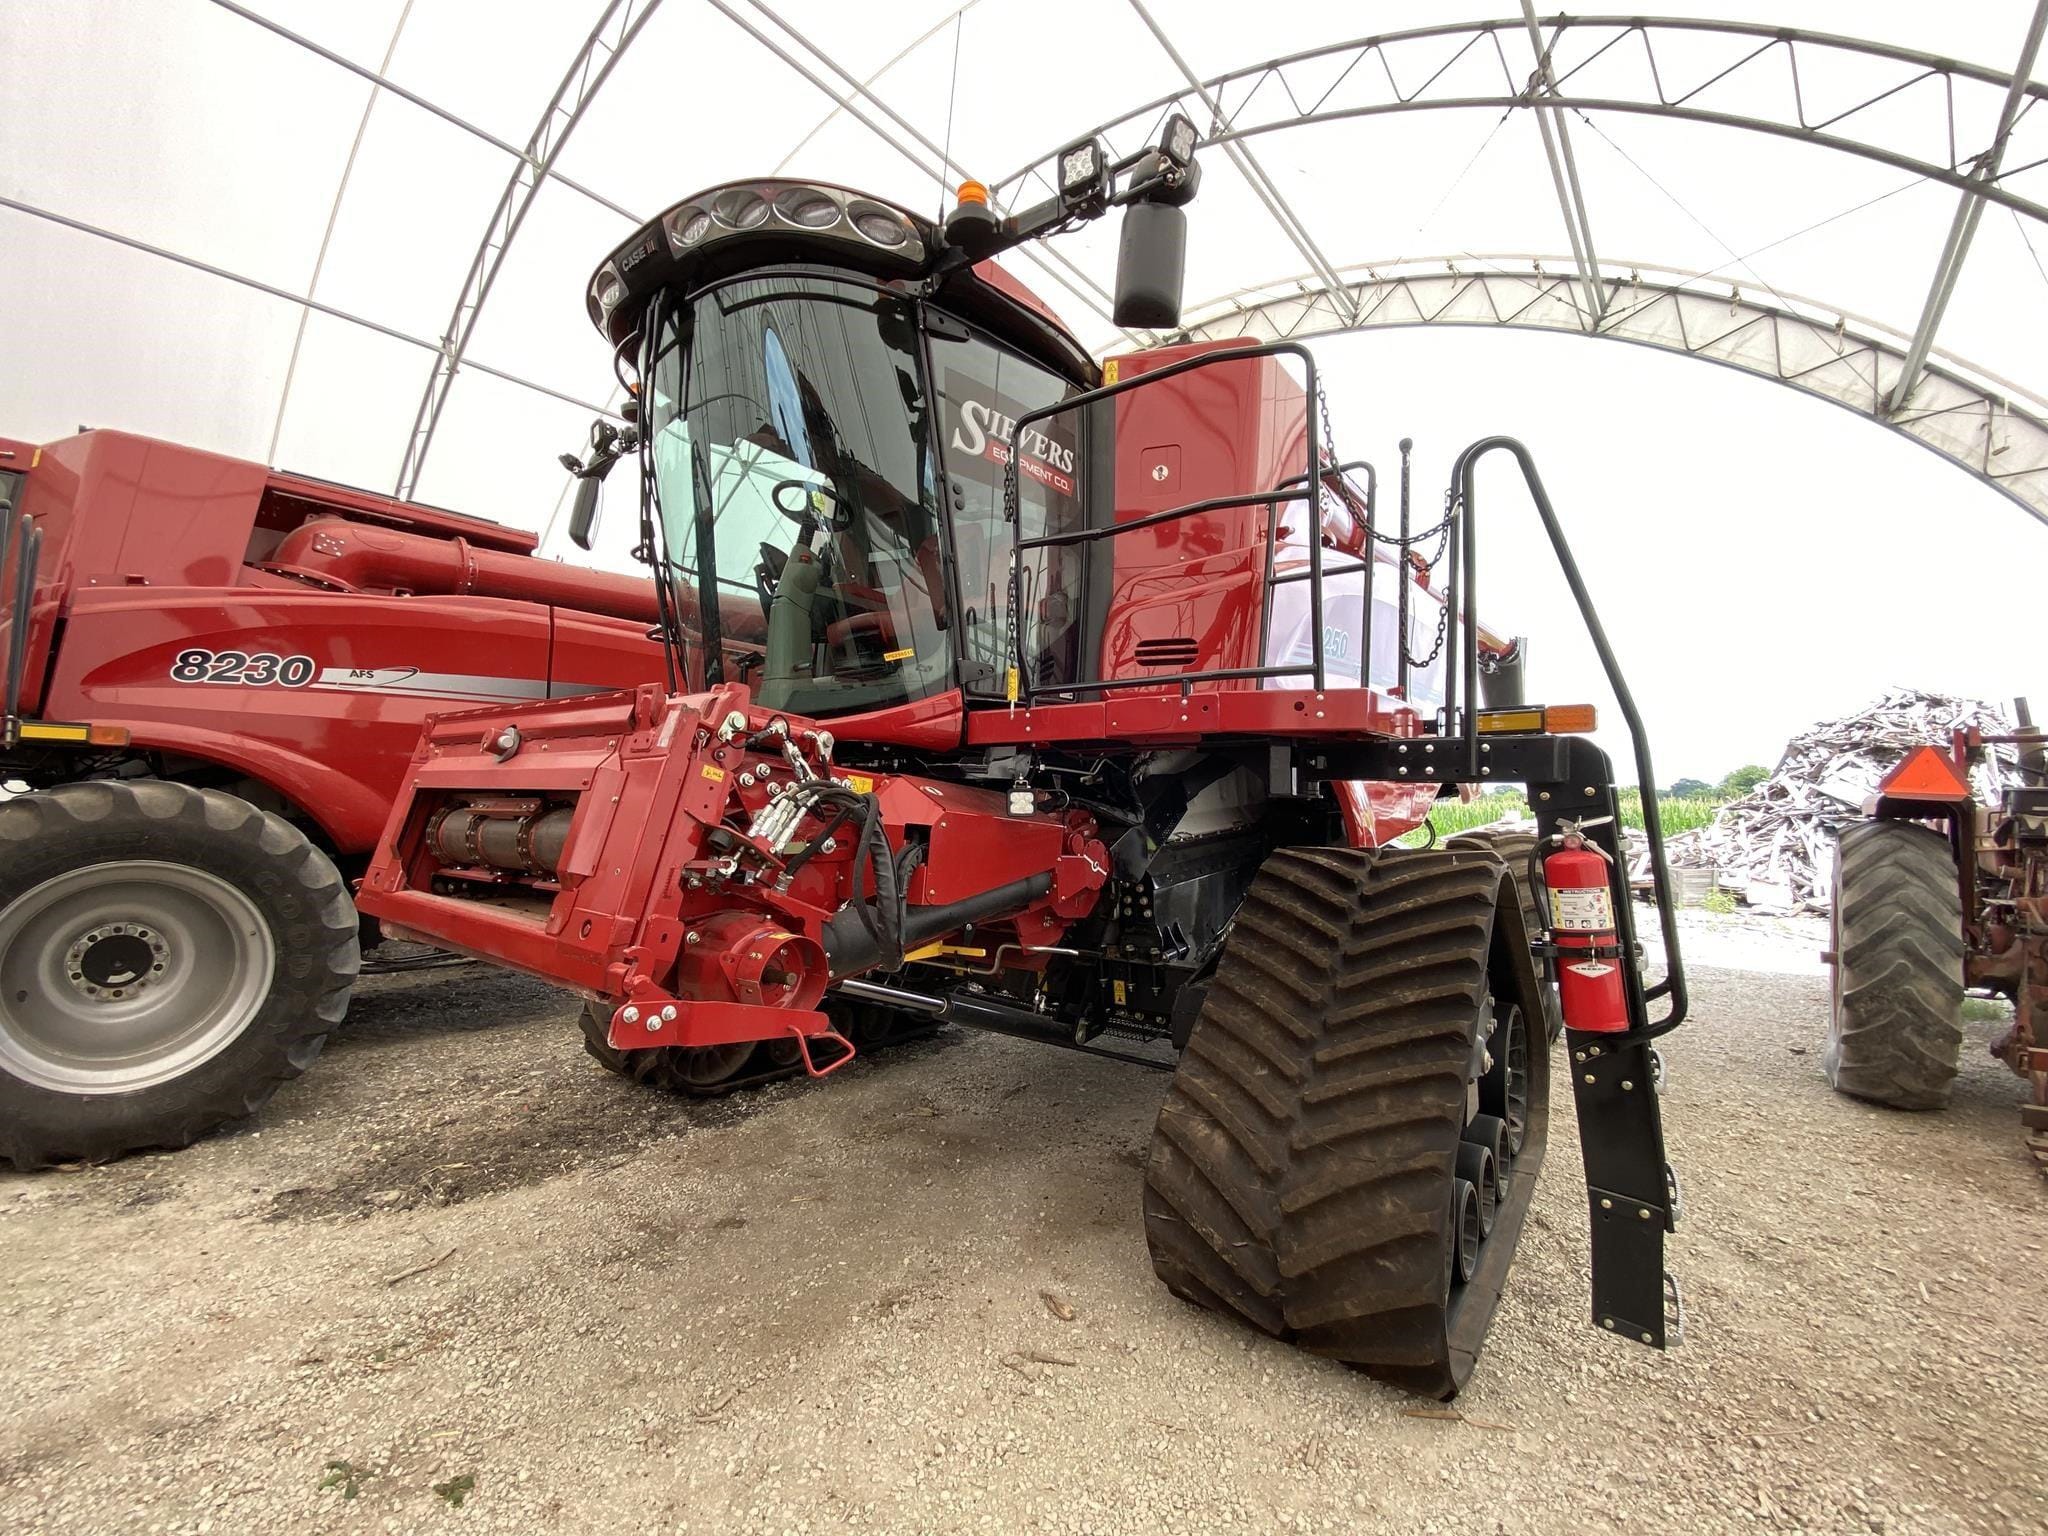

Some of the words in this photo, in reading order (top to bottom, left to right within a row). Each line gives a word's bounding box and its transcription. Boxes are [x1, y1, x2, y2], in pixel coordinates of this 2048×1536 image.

[622, 246, 646, 272] CASE
[952, 400, 1074, 474] SIEVERS
[992, 446, 1052, 482] EQPMENT
[1054, 473, 1070, 491] CO.
[1323, 625, 1349, 659] 250
[170, 648, 316, 688] 8230
[349, 668, 375, 680] AFS
